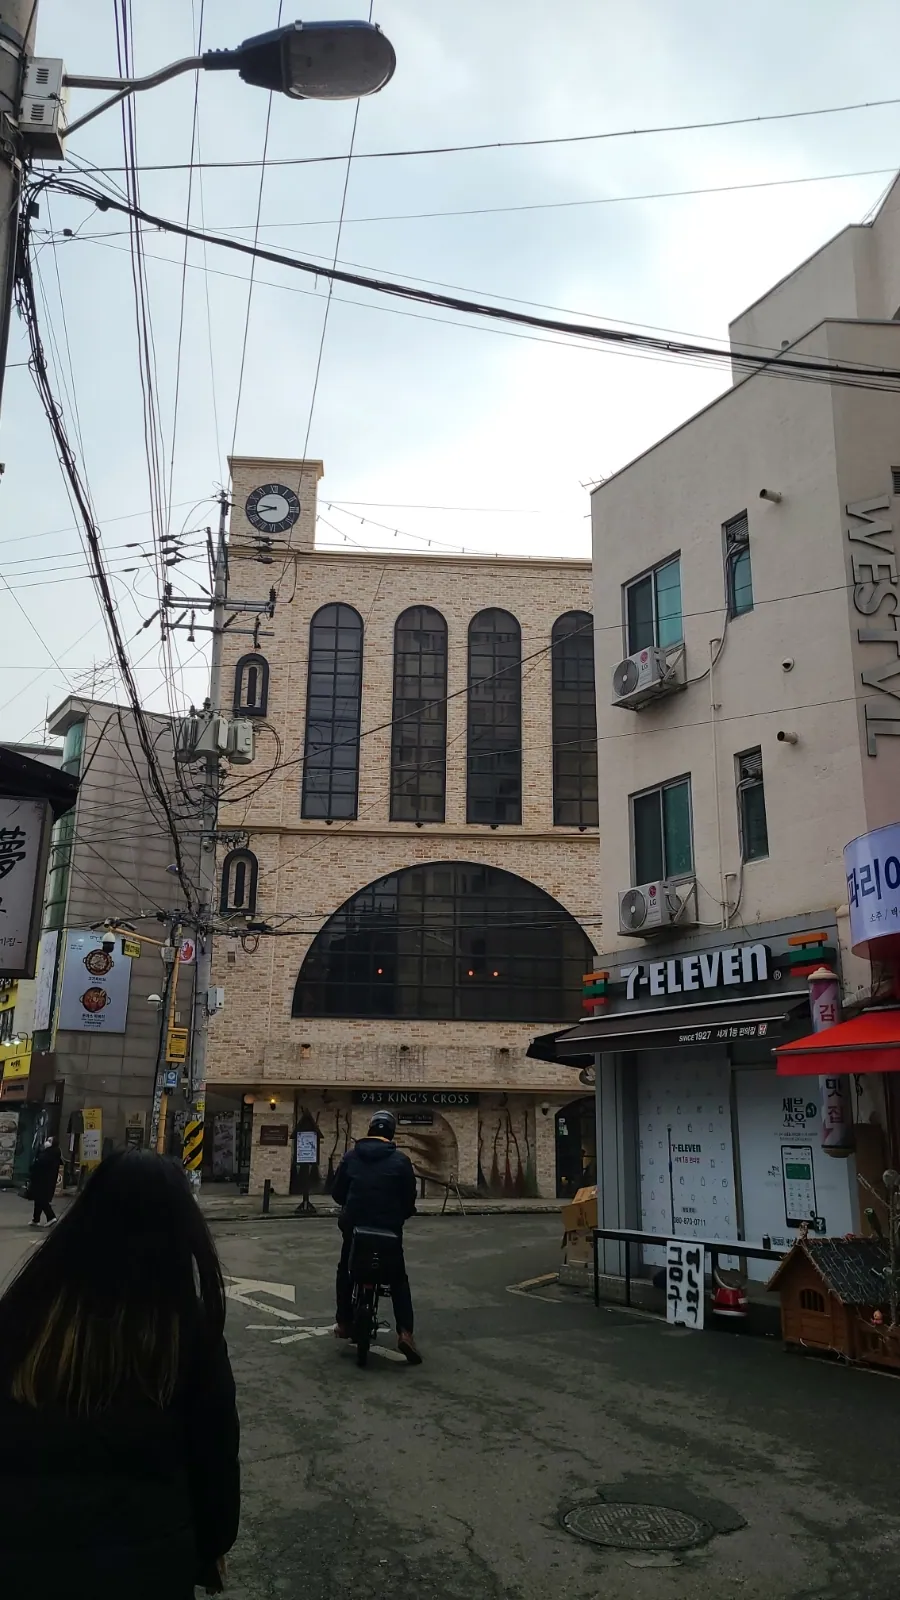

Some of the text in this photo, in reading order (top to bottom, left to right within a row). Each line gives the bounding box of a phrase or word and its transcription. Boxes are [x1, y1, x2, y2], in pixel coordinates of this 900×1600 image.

[361, 1092, 470, 1104] 943 KING'S CROSS
